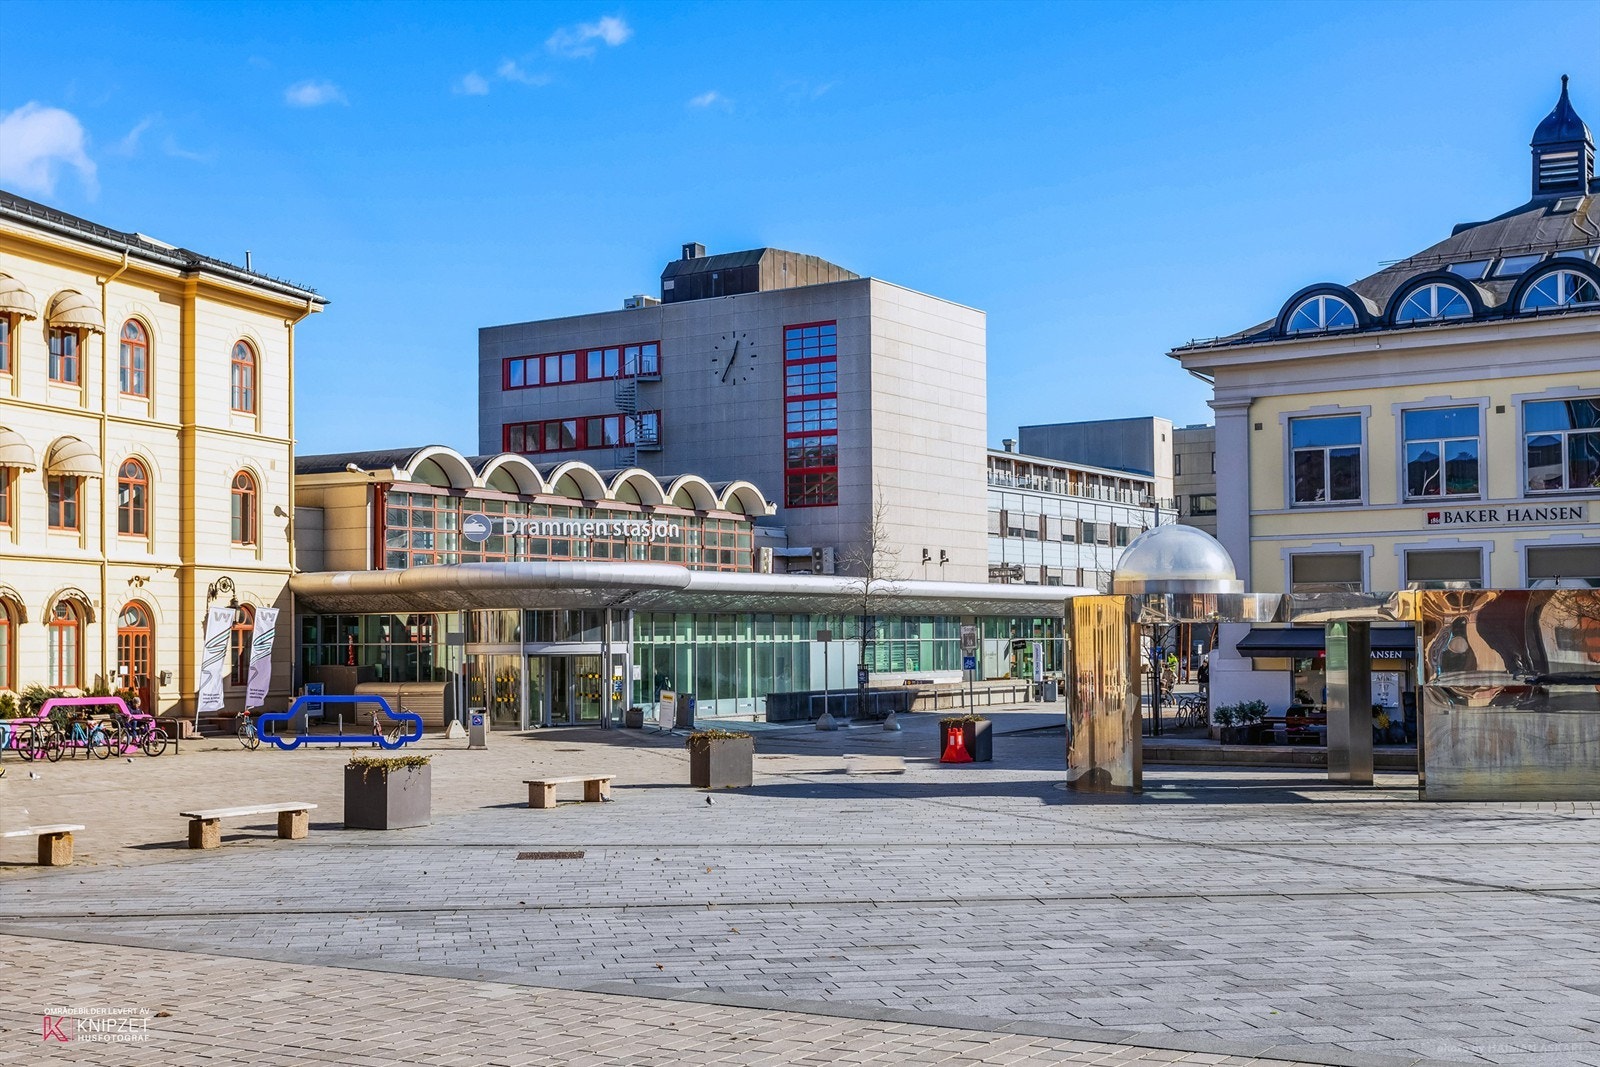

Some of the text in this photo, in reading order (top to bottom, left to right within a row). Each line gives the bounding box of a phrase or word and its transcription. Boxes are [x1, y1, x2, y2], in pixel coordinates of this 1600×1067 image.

[1444, 506, 1583, 524] BAKER HANSEN
[503, 517, 680, 541] Drammen stasjon
[1370, 650, 1402, 659] ANSEN
